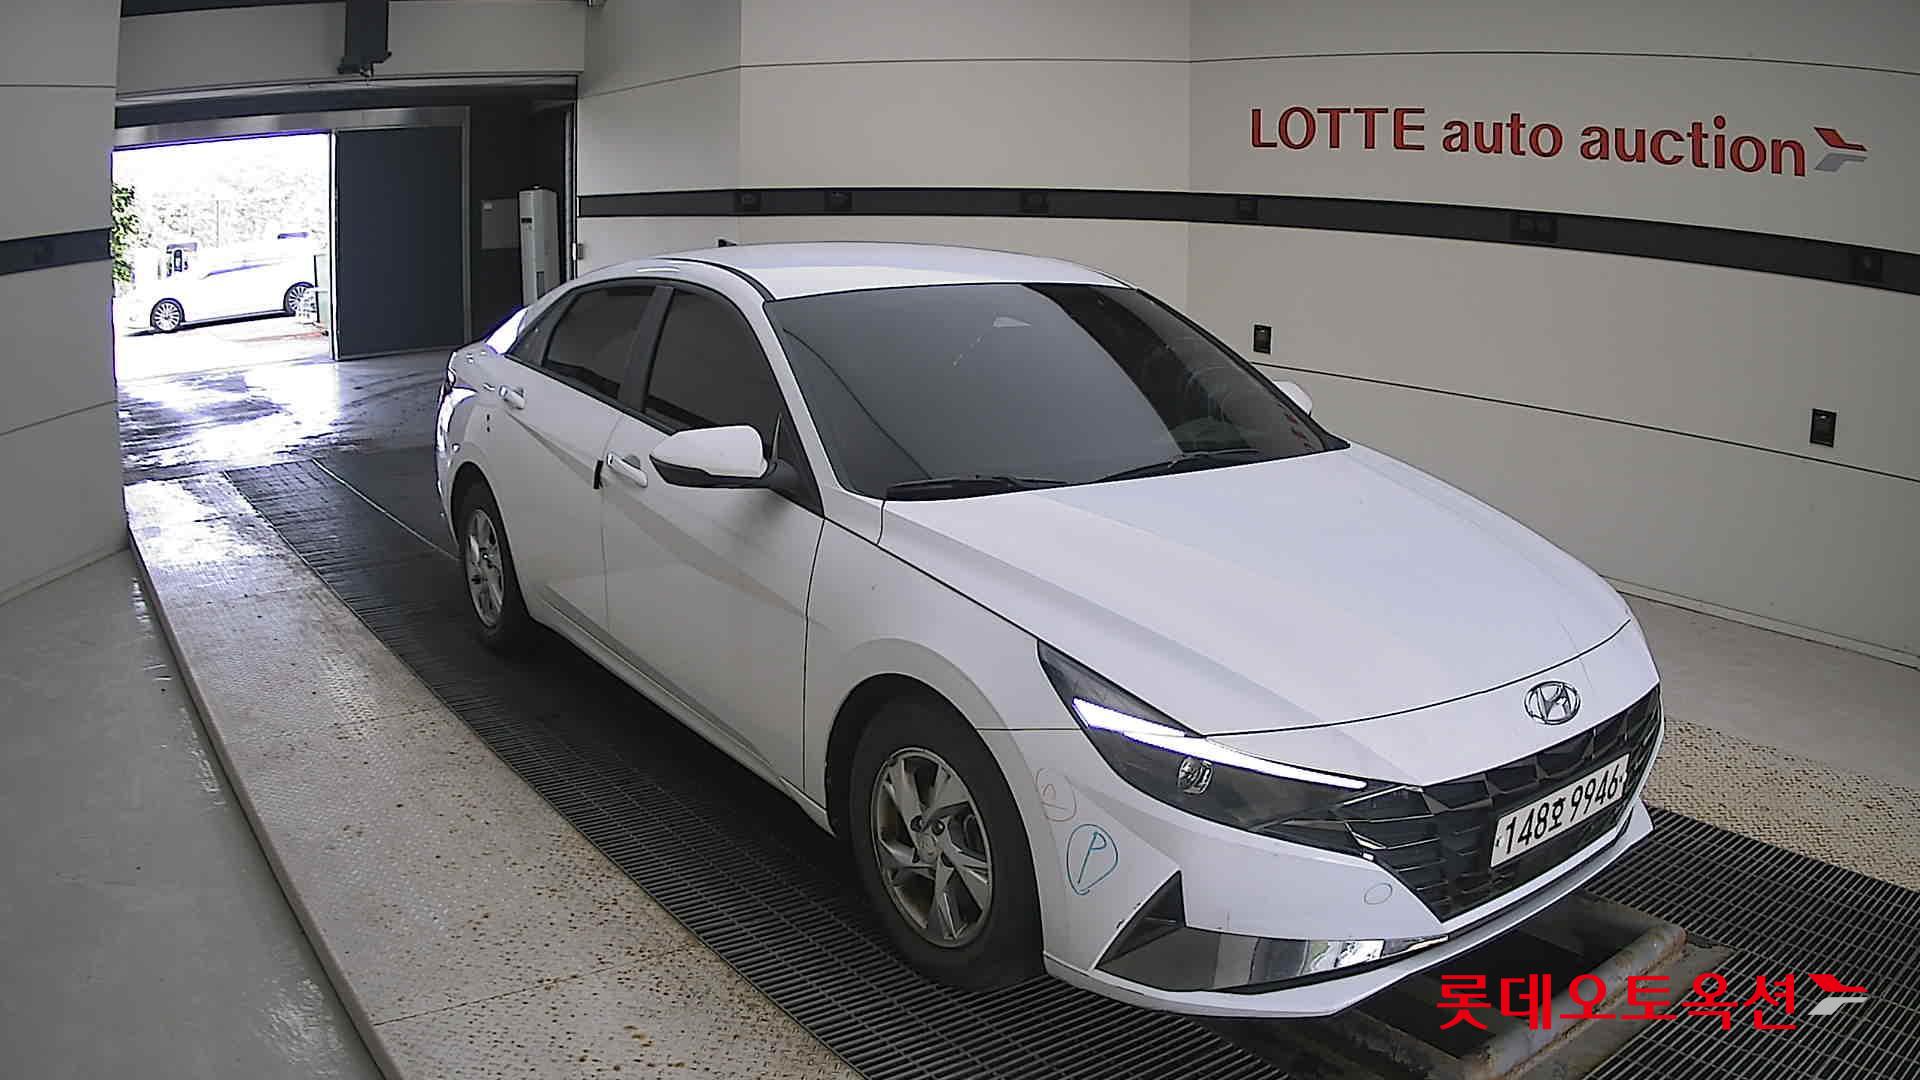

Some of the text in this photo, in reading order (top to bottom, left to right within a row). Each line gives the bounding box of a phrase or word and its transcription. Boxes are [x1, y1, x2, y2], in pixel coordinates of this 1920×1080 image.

[1251, 106, 1805, 177] LOTTE auto auction
[1506, 764, 1620, 854] 148호 9946
[1078, 832, 1107, 884] P
